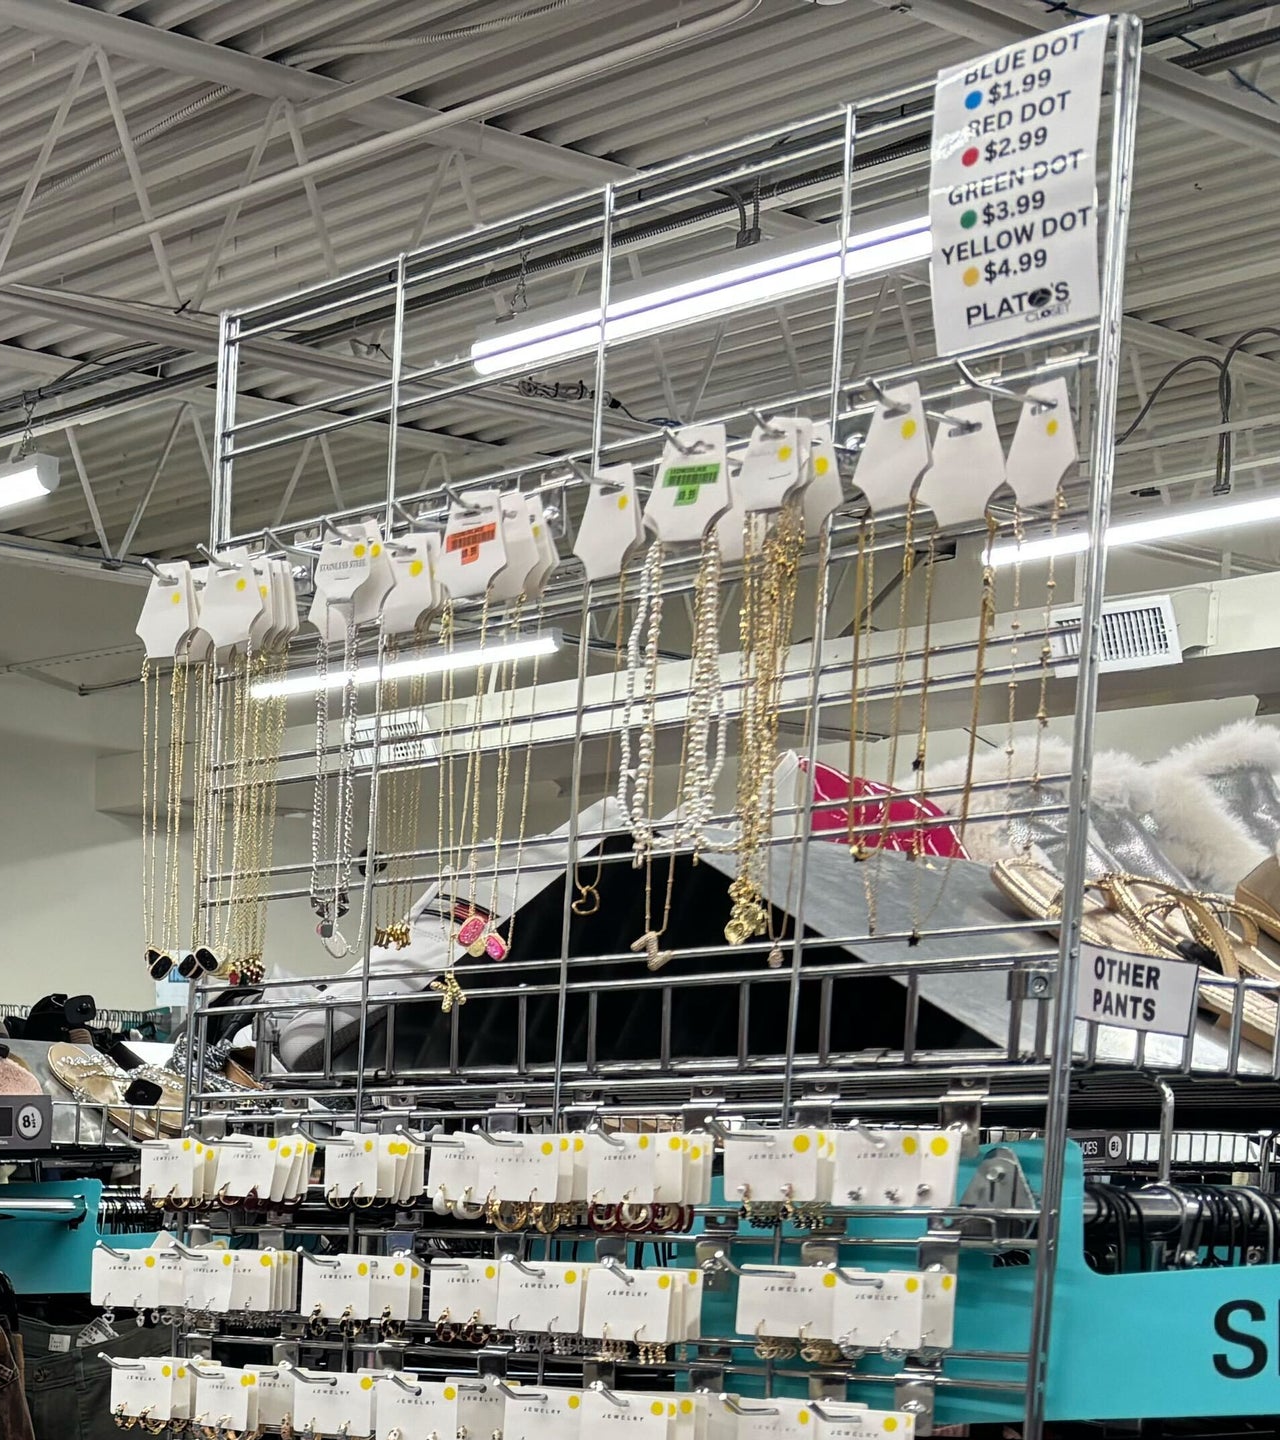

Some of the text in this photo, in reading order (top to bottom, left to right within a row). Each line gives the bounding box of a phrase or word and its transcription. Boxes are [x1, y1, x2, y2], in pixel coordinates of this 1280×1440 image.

[964, 30, 1085, 86] BLUE DOT
[988, 68, 1052, 105] $1.99
[968, 90, 1072, 138] RED DOT
[984, 127, 1048, 164] $2.99
[948, 149, 1084, 207] GREEN DOT
[982, 191, 1045, 226] $3.99
[942, 206, 1093, 265] YELLOW DOT
[984, 249, 1048, 284] $4.99
[1094, 956, 1161, 990] OTHER
[1093, 988, 1157, 1022] PANTS
[1213, 1299, 1280, 1379] S
